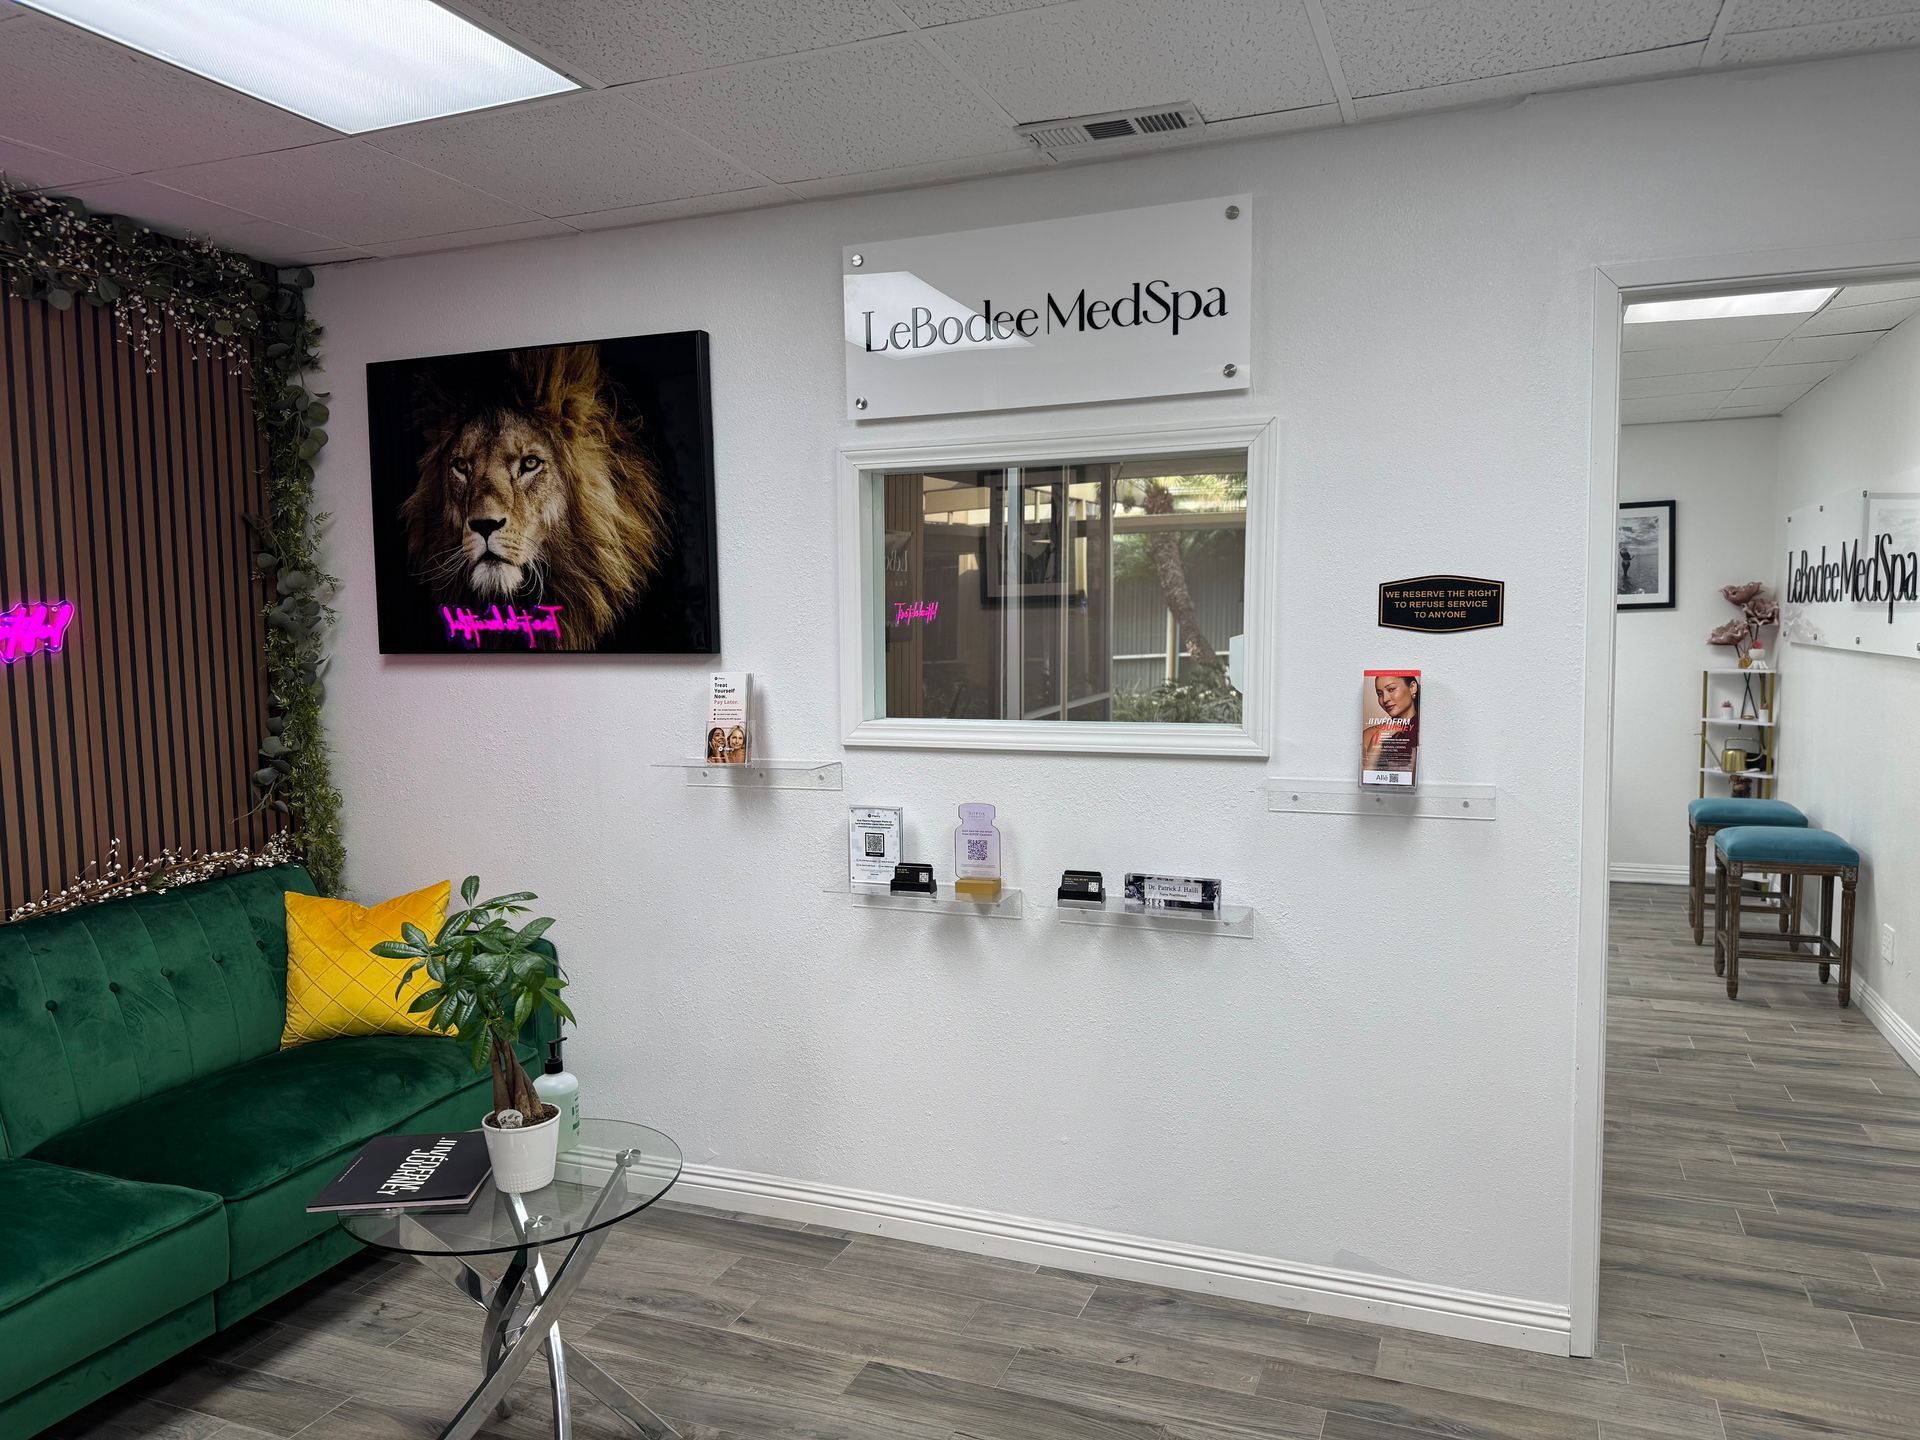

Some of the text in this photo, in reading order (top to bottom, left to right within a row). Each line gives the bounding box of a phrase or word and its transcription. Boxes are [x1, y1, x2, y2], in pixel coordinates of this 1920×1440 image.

[862, 280, 1229, 353] LeBodee MedSpa
[1402, 590, 1445, 598] RESERVE
[1467, 589, 1498, 597] RIGHT
[1447, 600, 1488, 608] SERVICE
[376, 1149, 430, 1195] JOURNEY
